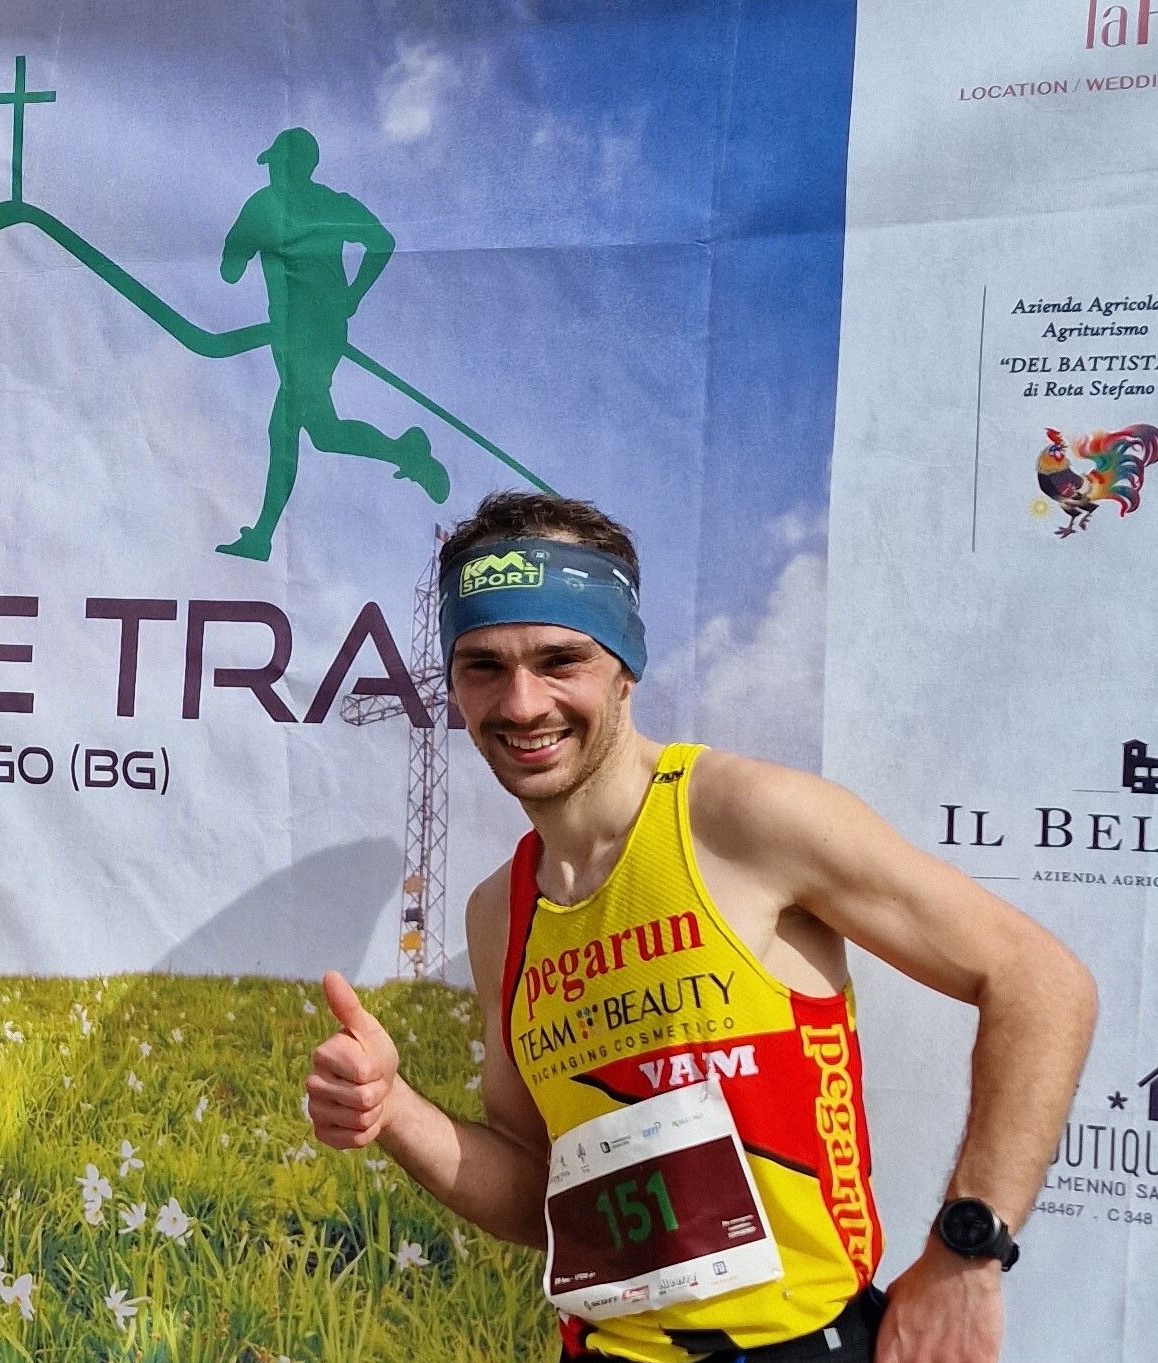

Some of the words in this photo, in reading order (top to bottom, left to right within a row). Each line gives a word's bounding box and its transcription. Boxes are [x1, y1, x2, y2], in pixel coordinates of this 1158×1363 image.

[1086, 0, 1158, 49] la
[958, 80, 1067, 101] LOCATION
[1086, 73, 1158, 92] WEDDI
[1011, 296, 1082, 314] Azienda
[1041, 321, 1149, 342] Agriturismo
[1058, 354, 1158, 372] BATTIST
[1023, 382, 1039, 397] di
[1044, 381, 1084, 397] Rota
[1089, 379, 1155, 400] Stefano
[463, 571, 539, 593] SPORT
[85, 597, 466, 731] TRA
[70, 743, 171, 795] (BG)
[938, 804, 1005, 847] IL
[1032, 870, 1107, 885] AZIENDA
[524, 910, 706, 1023] pegarun
[519, 1016, 577, 1066] TEAM
[603, 971, 736, 1030] BEAUTY
[614, 1016, 735, 1053] COSMETICO
[639, 1044, 760, 1089] VAM
[1051, 1122, 1158, 1177] UTIQU
[596, 1169, 680, 1251] 151
